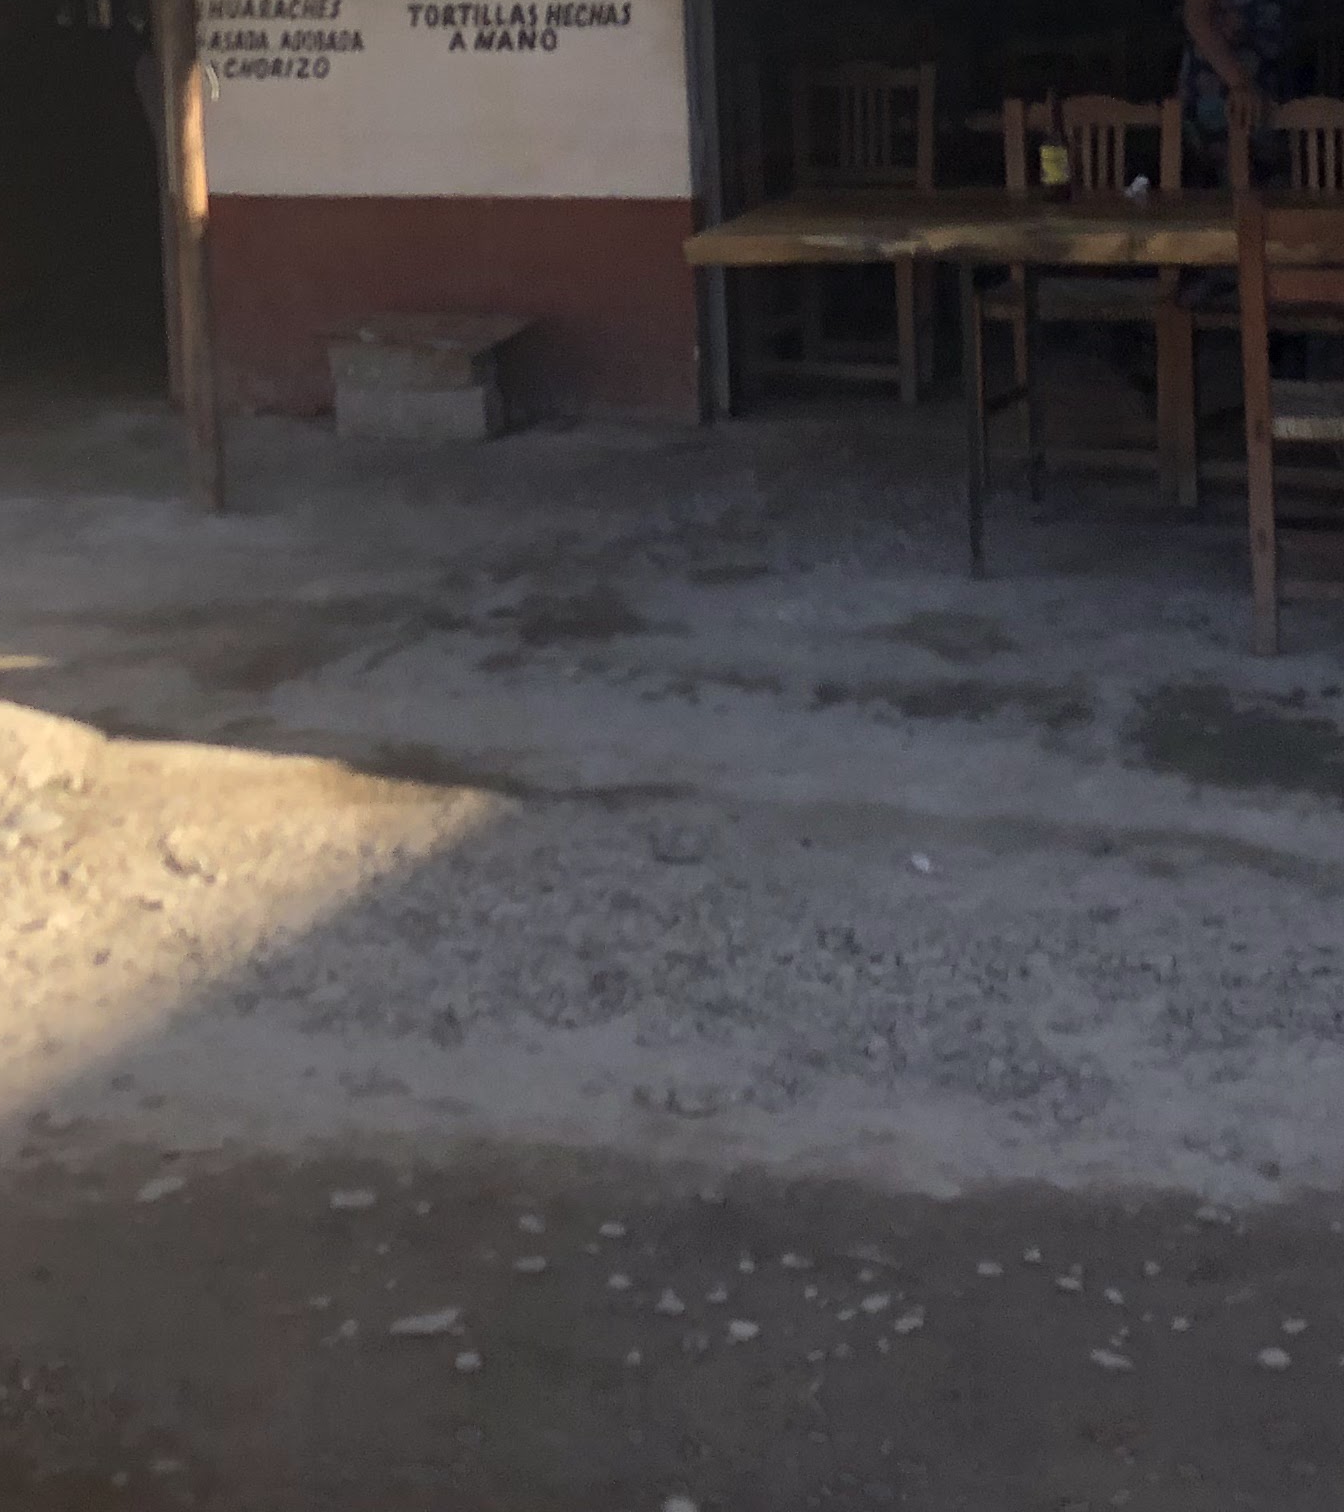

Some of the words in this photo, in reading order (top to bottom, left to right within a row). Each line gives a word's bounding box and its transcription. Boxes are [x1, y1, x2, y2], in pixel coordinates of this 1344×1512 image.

[408, 2, 538, 28] TORTILLAS
[546, 1, 631, 27] HECHAS
[448, 30, 467, 51] A
[474, 27, 557, 51] MANO
[224, 55, 331, 79] CHORIZO
